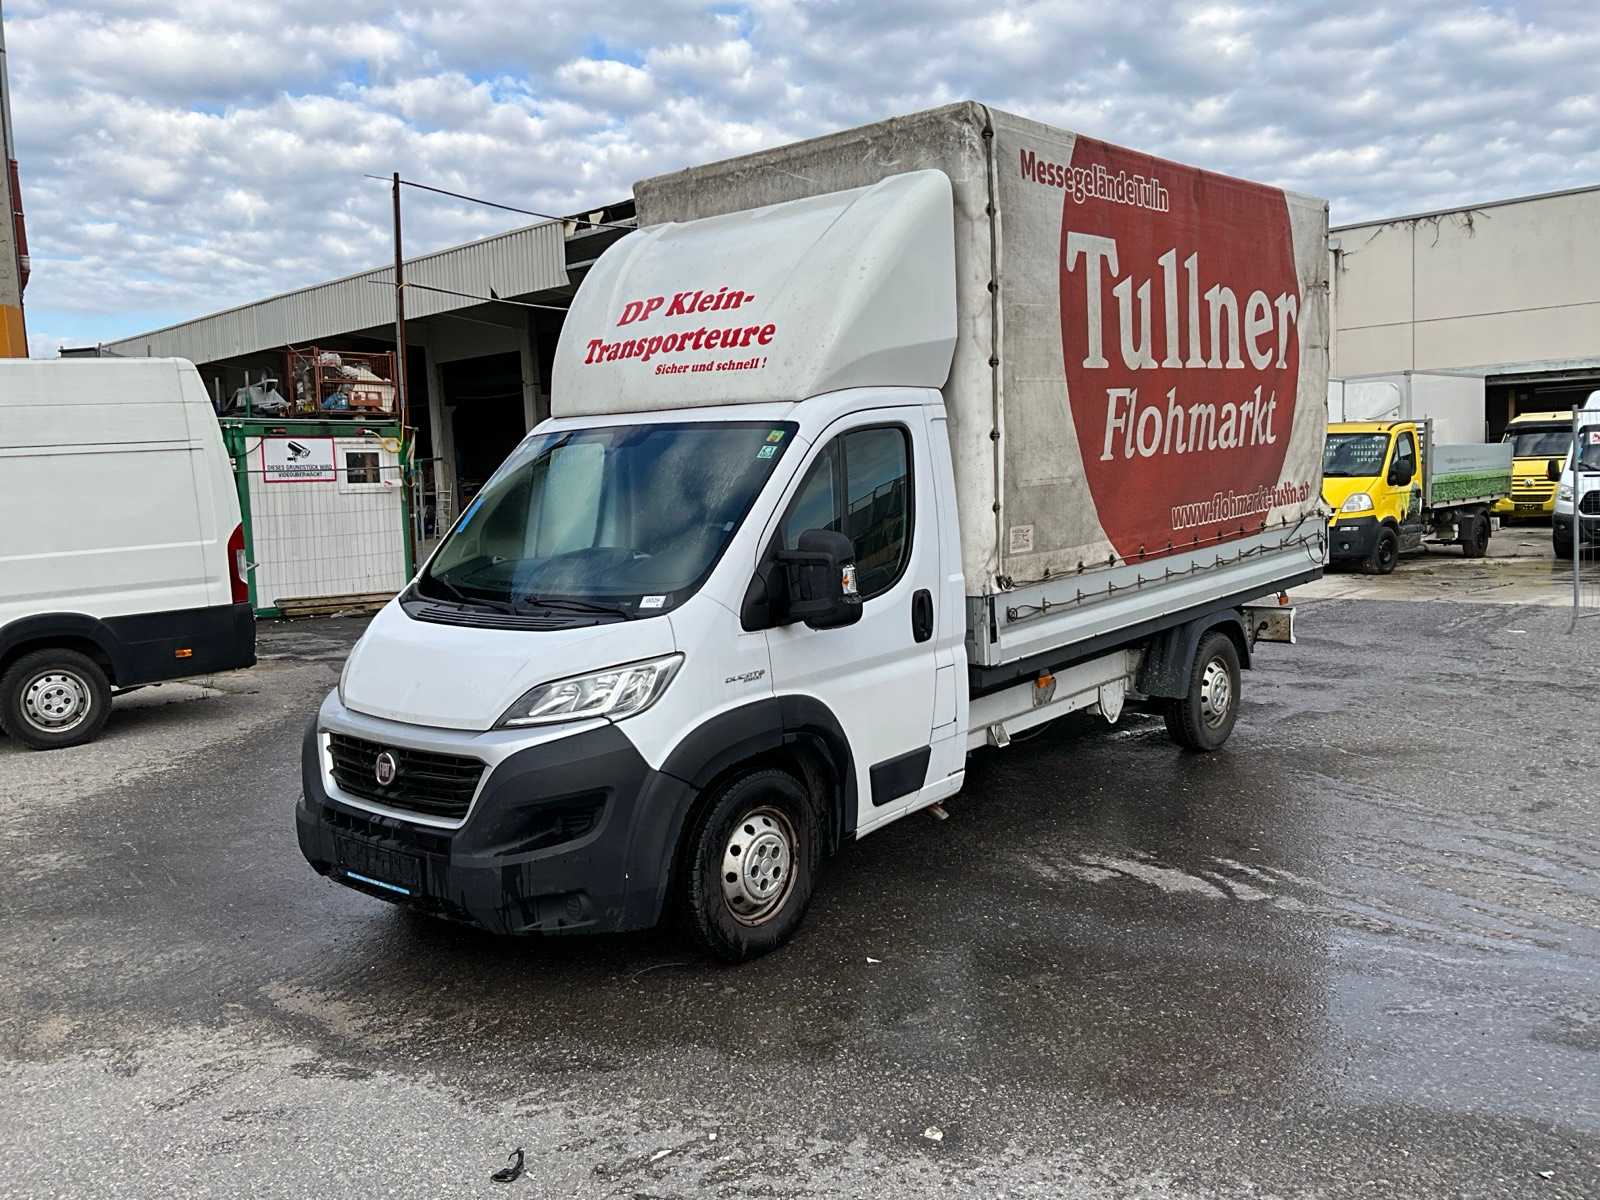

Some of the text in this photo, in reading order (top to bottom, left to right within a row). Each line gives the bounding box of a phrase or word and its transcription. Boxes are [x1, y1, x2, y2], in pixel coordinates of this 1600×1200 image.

[616, 287, 755, 327] DP Klein-
[1066, 231, 1298, 371] Tullner
[584, 323, 776, 365] Transporteure
[655, 364, 690, 375] Sicher
[691, 361, 714, 372] und
[1100, 384, 1277, 461] Flohmarkt
